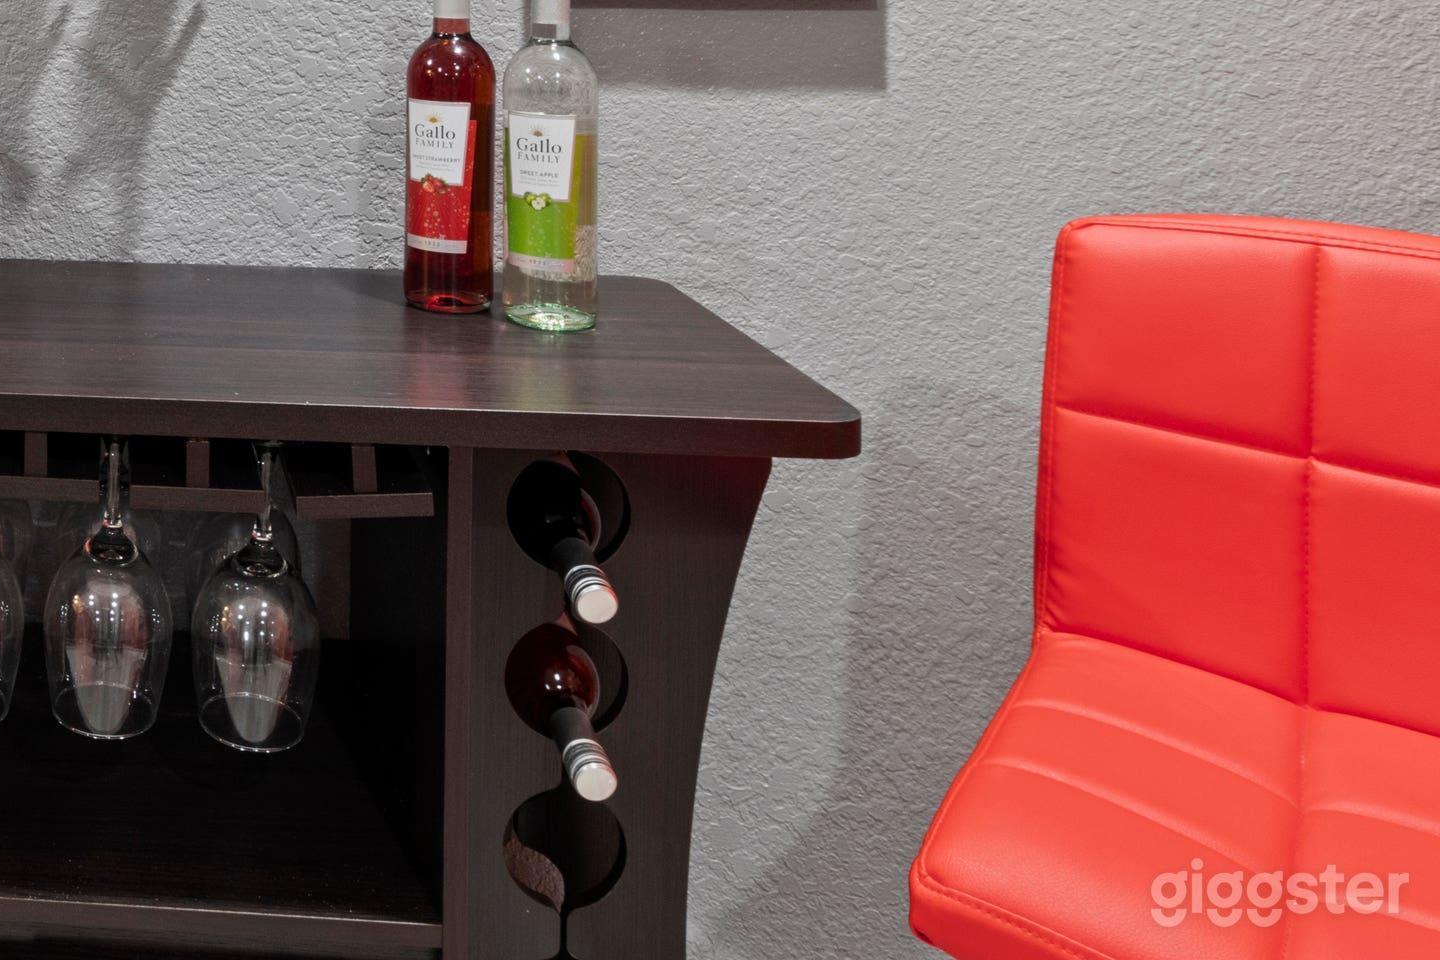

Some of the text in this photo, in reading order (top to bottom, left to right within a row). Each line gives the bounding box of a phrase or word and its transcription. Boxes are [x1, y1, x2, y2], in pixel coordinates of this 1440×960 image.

[415, 123, 456, 139] Gallo
[416, 137, 453, 149] FAMILY
[516, 137, 562, 154] Gallo
[517, 151, 560, 164] FAMILY
